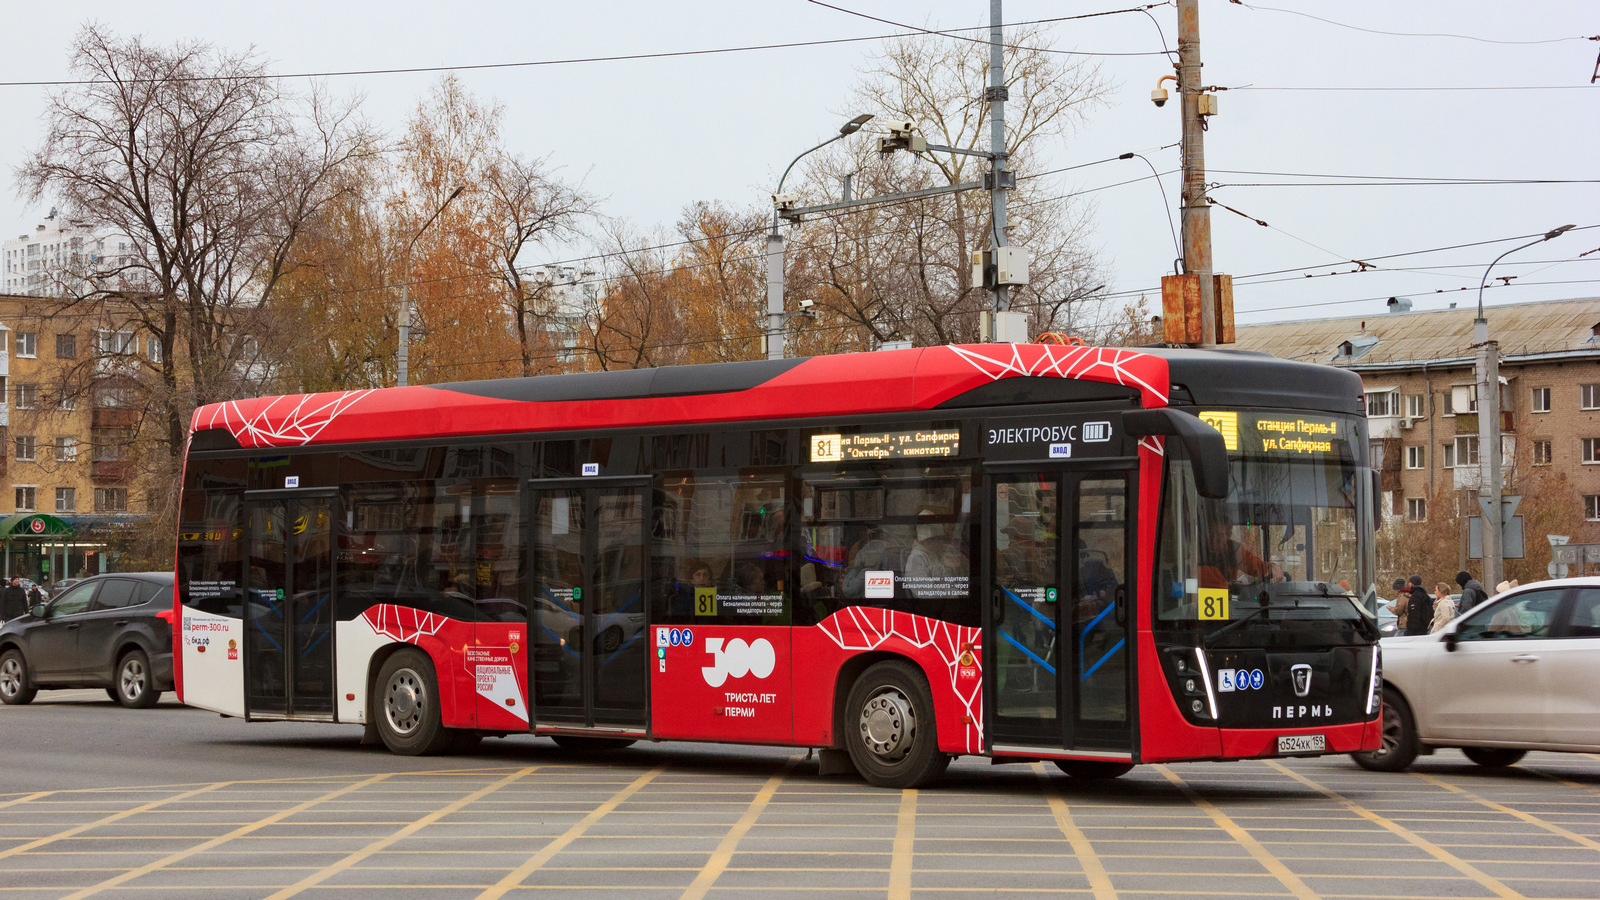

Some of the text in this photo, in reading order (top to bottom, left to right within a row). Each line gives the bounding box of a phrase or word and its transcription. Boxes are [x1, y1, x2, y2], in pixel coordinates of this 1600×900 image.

[1257, 420, 1296, 434] станция
[899, 434, 912, 445] ул.
[988, 425, 1077, 445] ЭЛЕКТРОБУС
[817, 439, 833, 457] 81
[903, 445, 951, 457] кинотеатр
[1052, 446, 1068, 455] ВХОД
[1263, 437, 1331, 454] ул. Сапфирная
[699, 594, 714, 613] 81
[1204, 596, 1224, 618] 81
[191, 622, 229, 633] perm-300.ru
[191, 635, 210, 647] бкд.рф
[701, 637, 776, 688] 300
[476, 666, 511, 675] НАЦИОНАЛЬНЫЕ
[476, 674, 496, 683] ПРОЕКТЫ
[476, 683, 494, 691] РОССИИ
[724, 692, 777, 704] ТРИСТА ЛЕТ
[724, 706, 755, 717] ПЕРМИ
[1272, 704, 1333, 719] ПЕРМЬ
[1280, 735, 1324, 751] О524ХК 159
